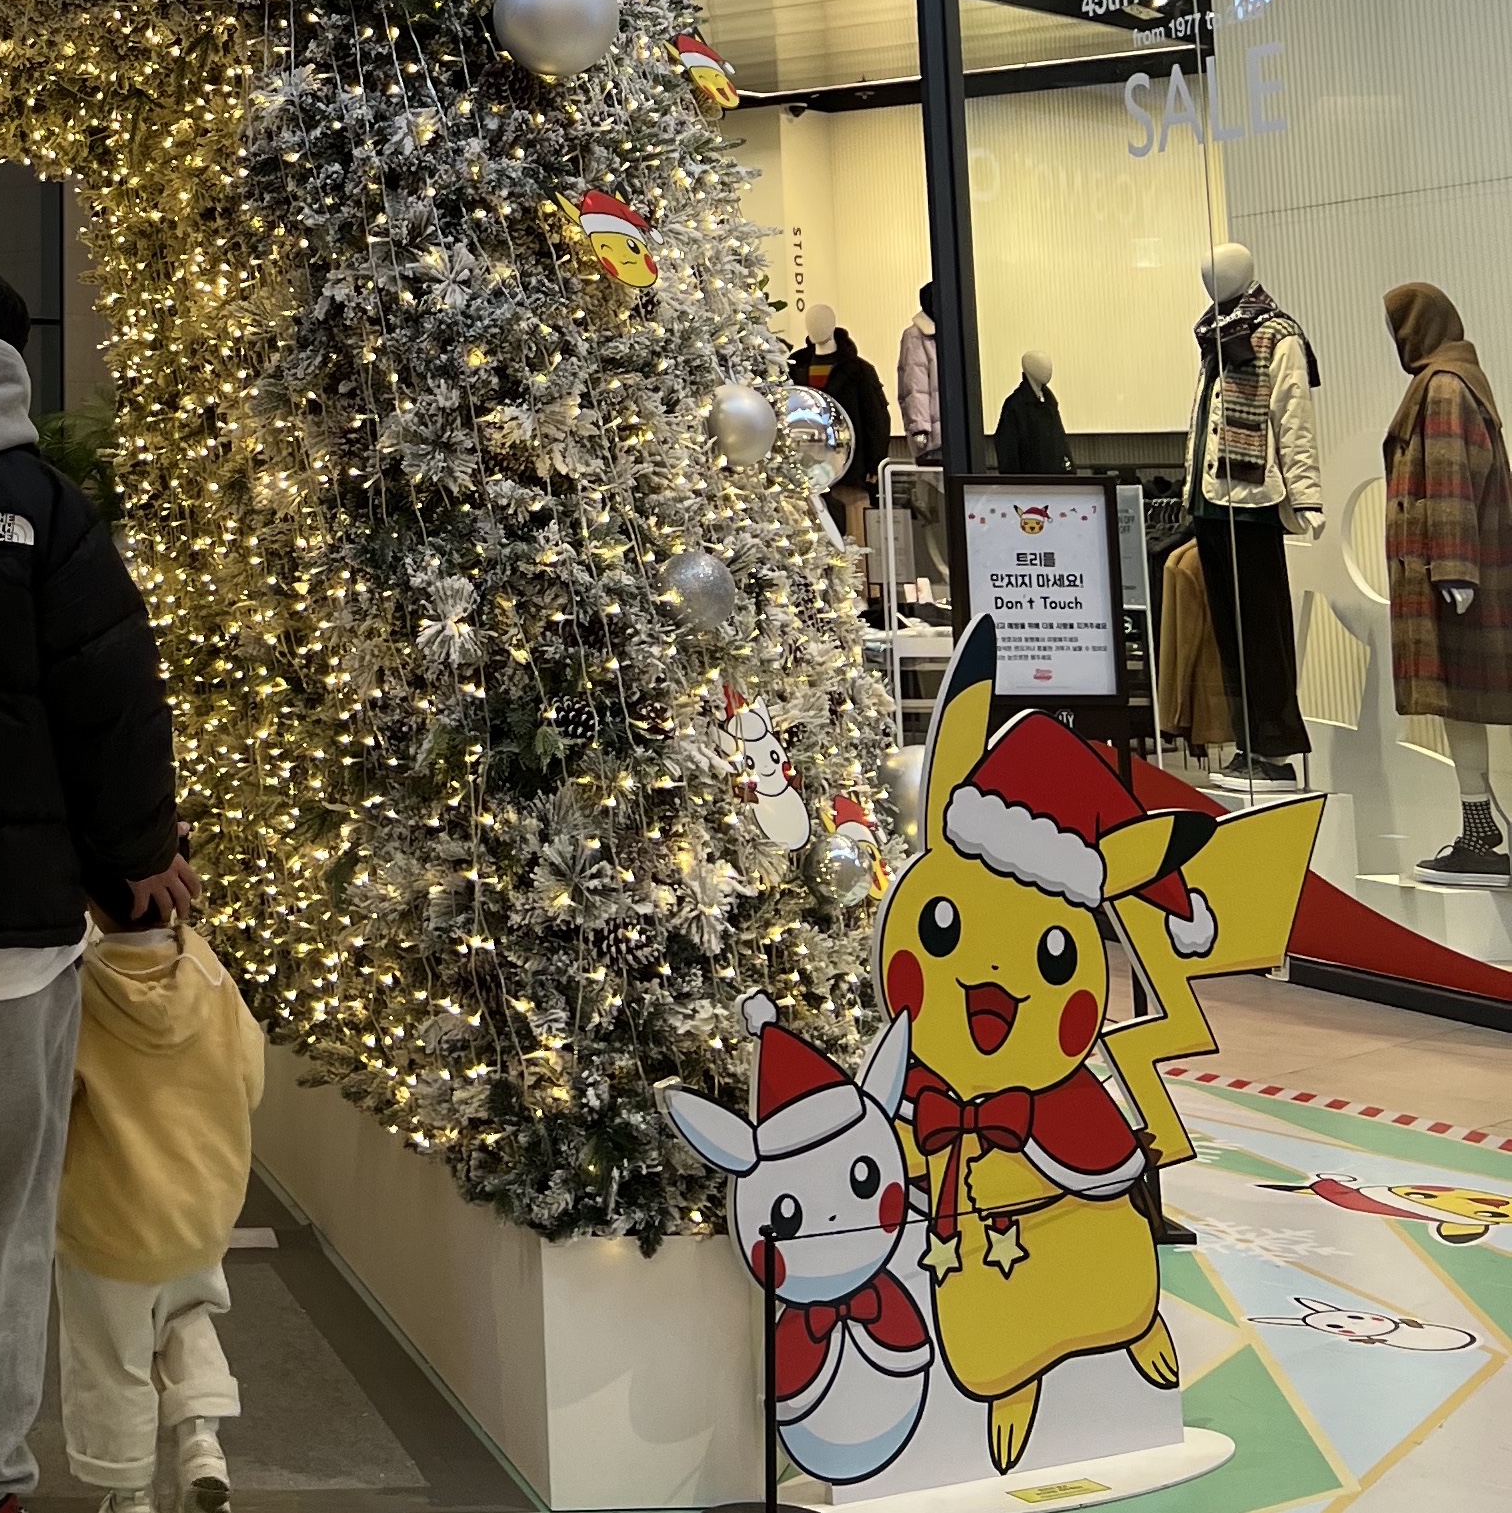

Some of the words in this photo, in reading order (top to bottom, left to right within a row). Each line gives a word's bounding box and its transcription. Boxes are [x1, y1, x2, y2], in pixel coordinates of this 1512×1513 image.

[1132, 26, 1165, 48] from
[1169, 13, 1201, 38] 1977
[1123, 42, 1289, 158] SALE
[792, 226, 806, 313] STUDIO
[1015, 551, 1056, 568] 트리를
[989, 573, 1033, 589] 만지지
[1036, 573, 1085, 589] 마세요!
[994, 596, 1035, 610] Don't
[1040, 596, 1083, 610] Touch
